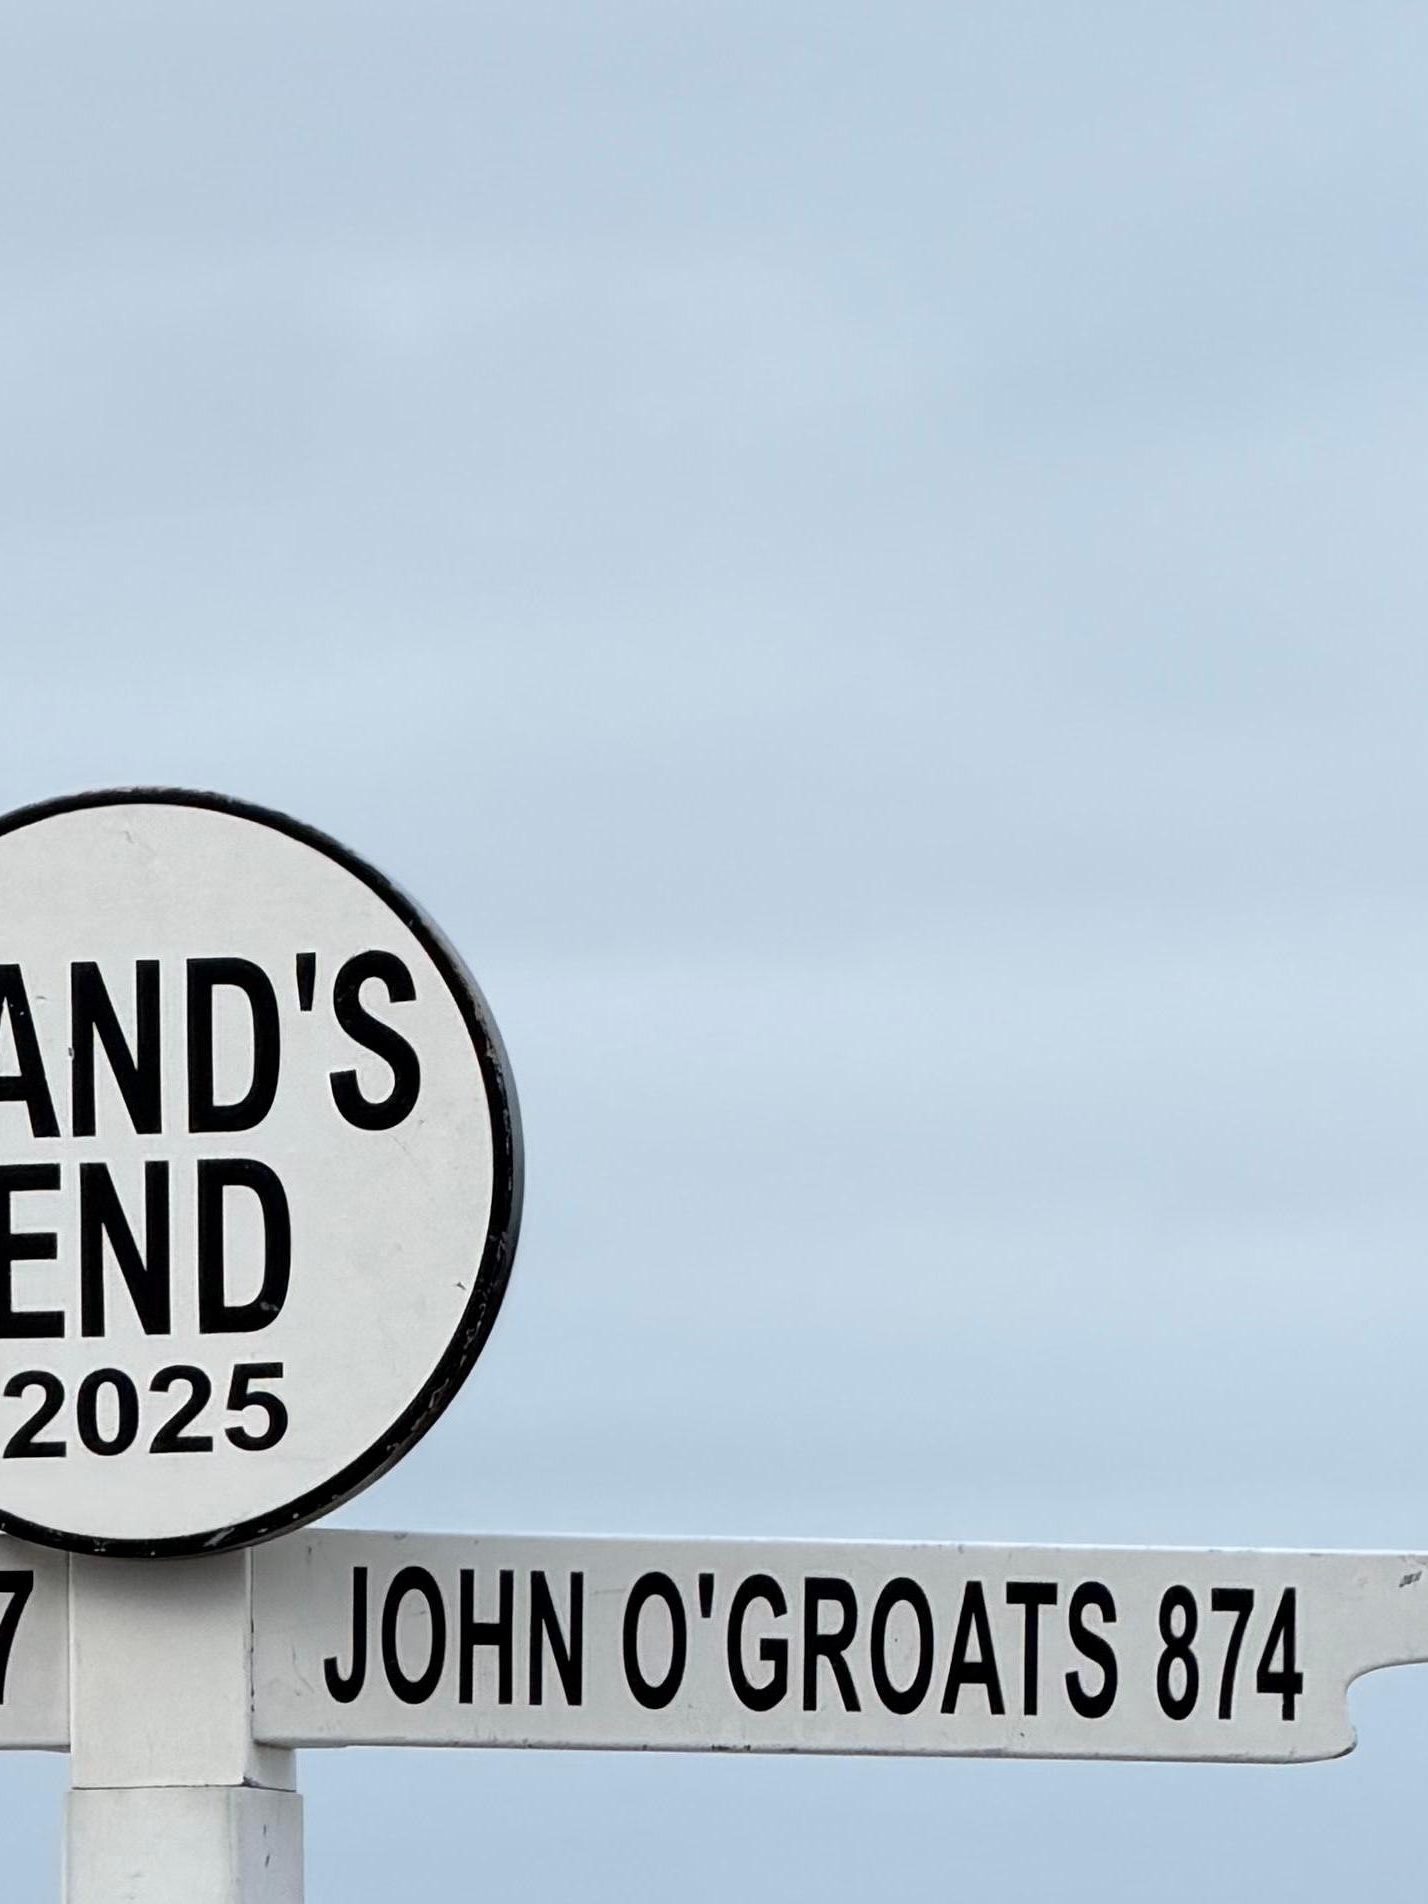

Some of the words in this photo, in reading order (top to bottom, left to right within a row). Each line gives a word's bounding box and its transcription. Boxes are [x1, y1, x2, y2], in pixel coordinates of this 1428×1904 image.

[2, 1362, 288, 1459] 2025
[323, 1565, 584, 1706] JOHN
[622, 1571, 1118, 1719] O'GROATS
[1156, 1584, 1303, 1721] 874
